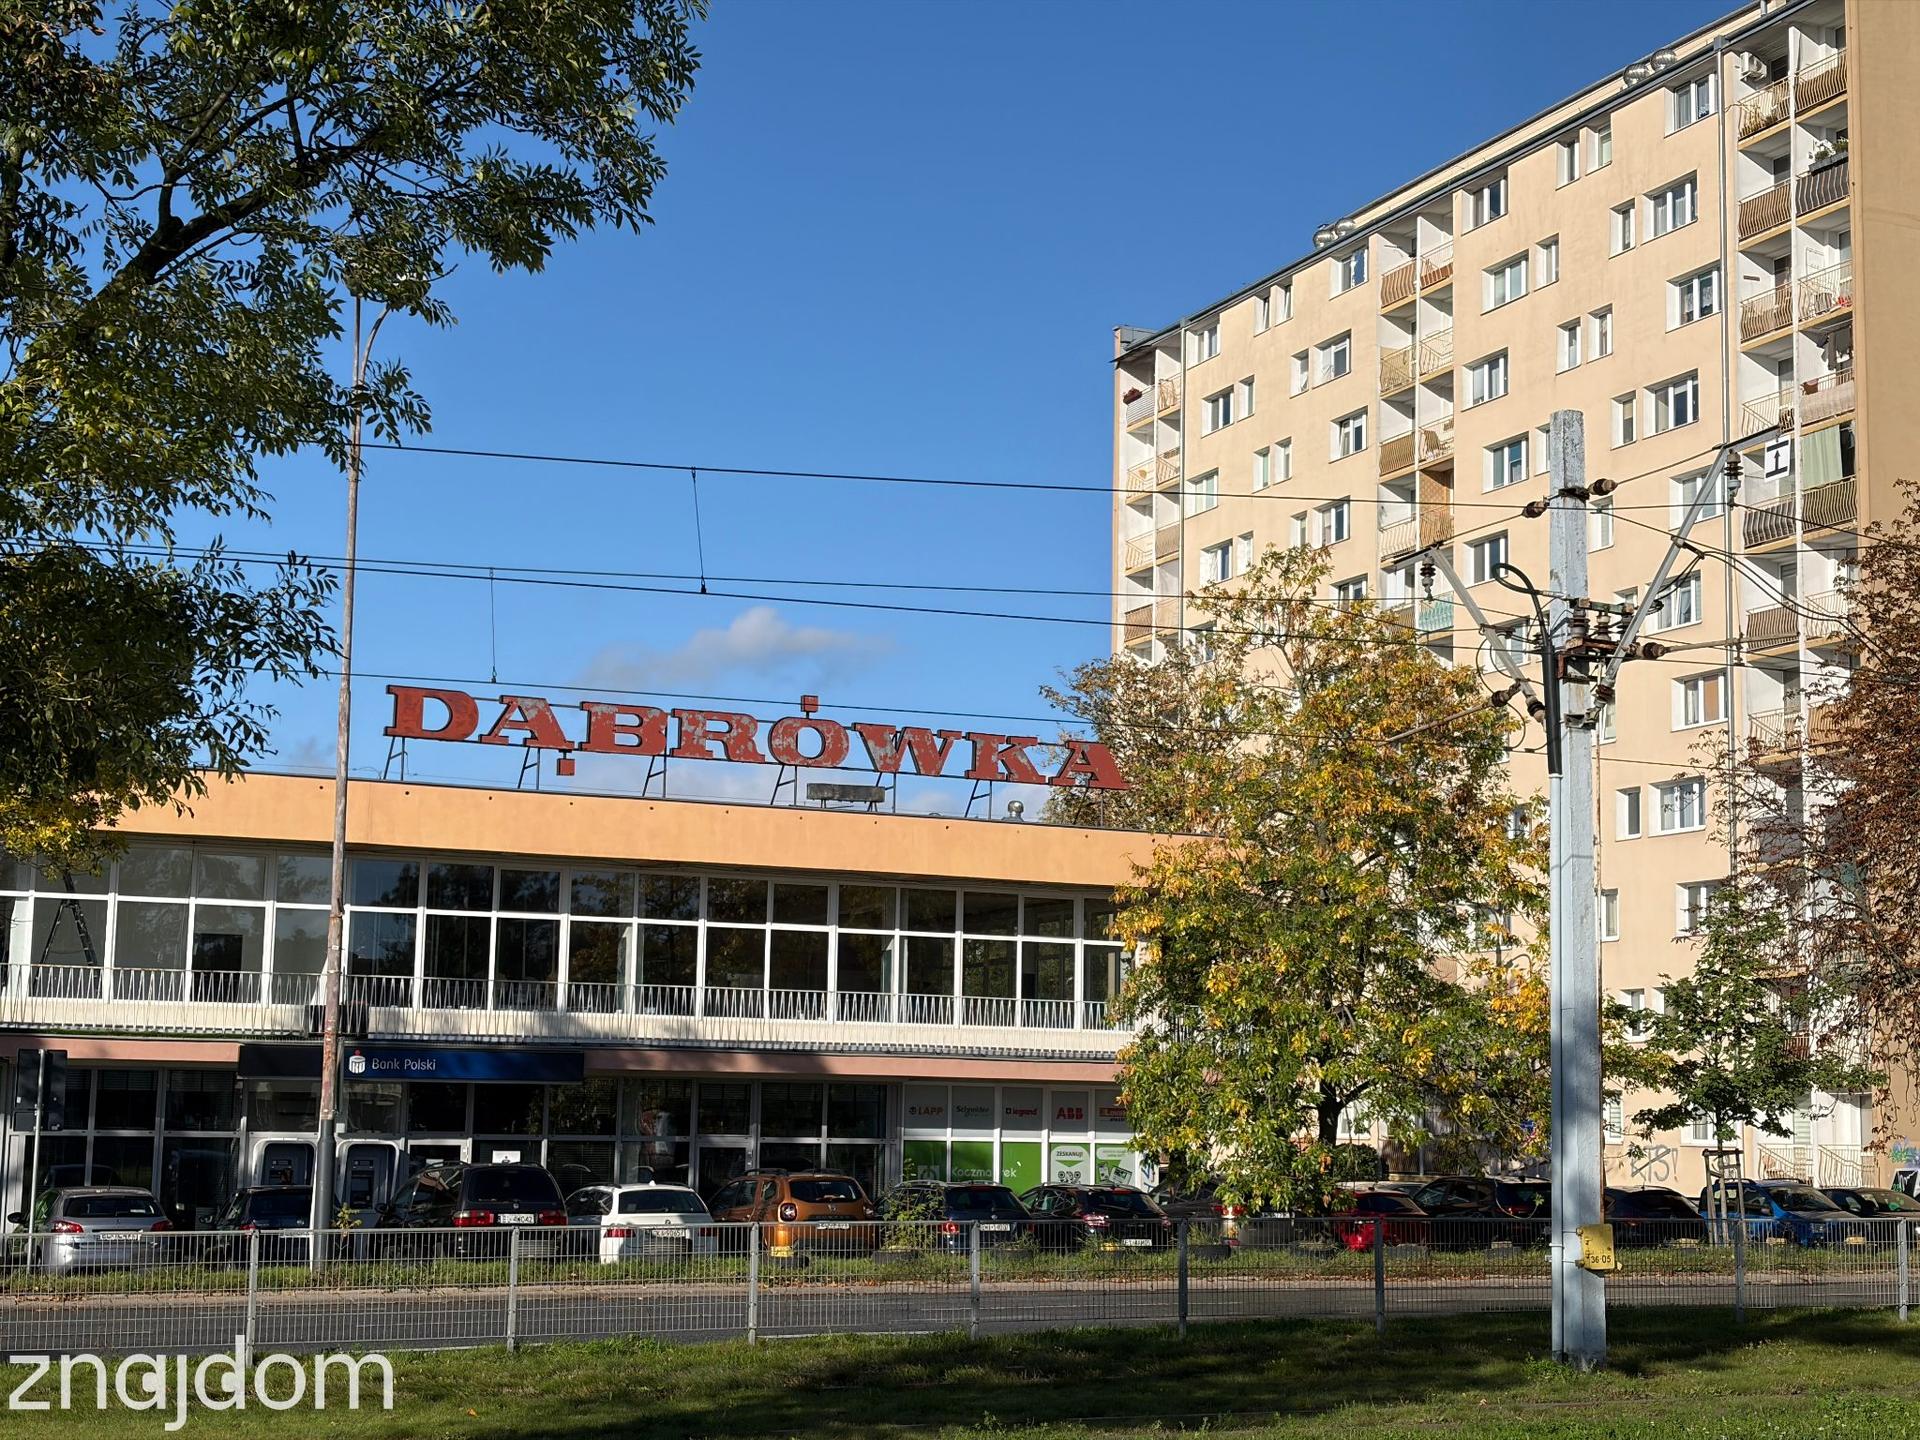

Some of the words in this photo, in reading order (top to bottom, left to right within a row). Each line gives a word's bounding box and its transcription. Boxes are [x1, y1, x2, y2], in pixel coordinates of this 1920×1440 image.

[384, 684, 1132, 790] DĄBRÓWKA
[371, 1057, 400, 1070] Bank
[404, 1058, 436, 1071] Polski
[918, 1106, 944, 1115] LAPP
[1056, 1107, 1083, 1119] ABB
